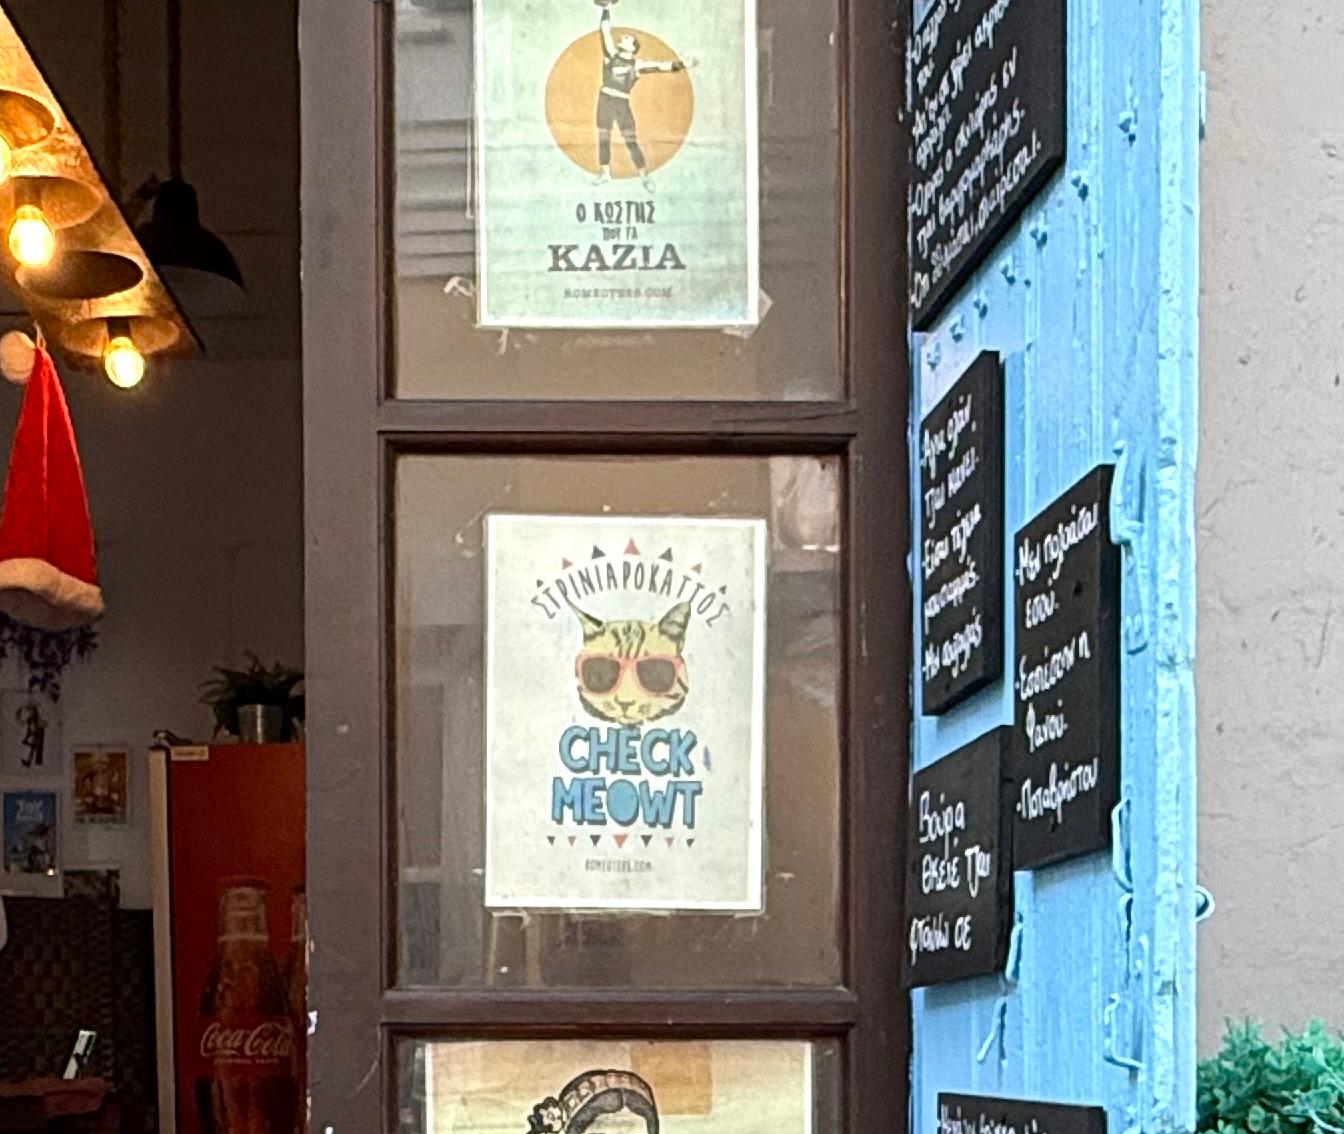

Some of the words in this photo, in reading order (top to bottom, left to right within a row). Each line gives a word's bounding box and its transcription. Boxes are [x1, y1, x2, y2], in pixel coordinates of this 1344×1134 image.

[576, 203, 586, 222] Ο
[558, 725, 699, 777] CHECK
[552, 777, 703, 829] MEOWT
